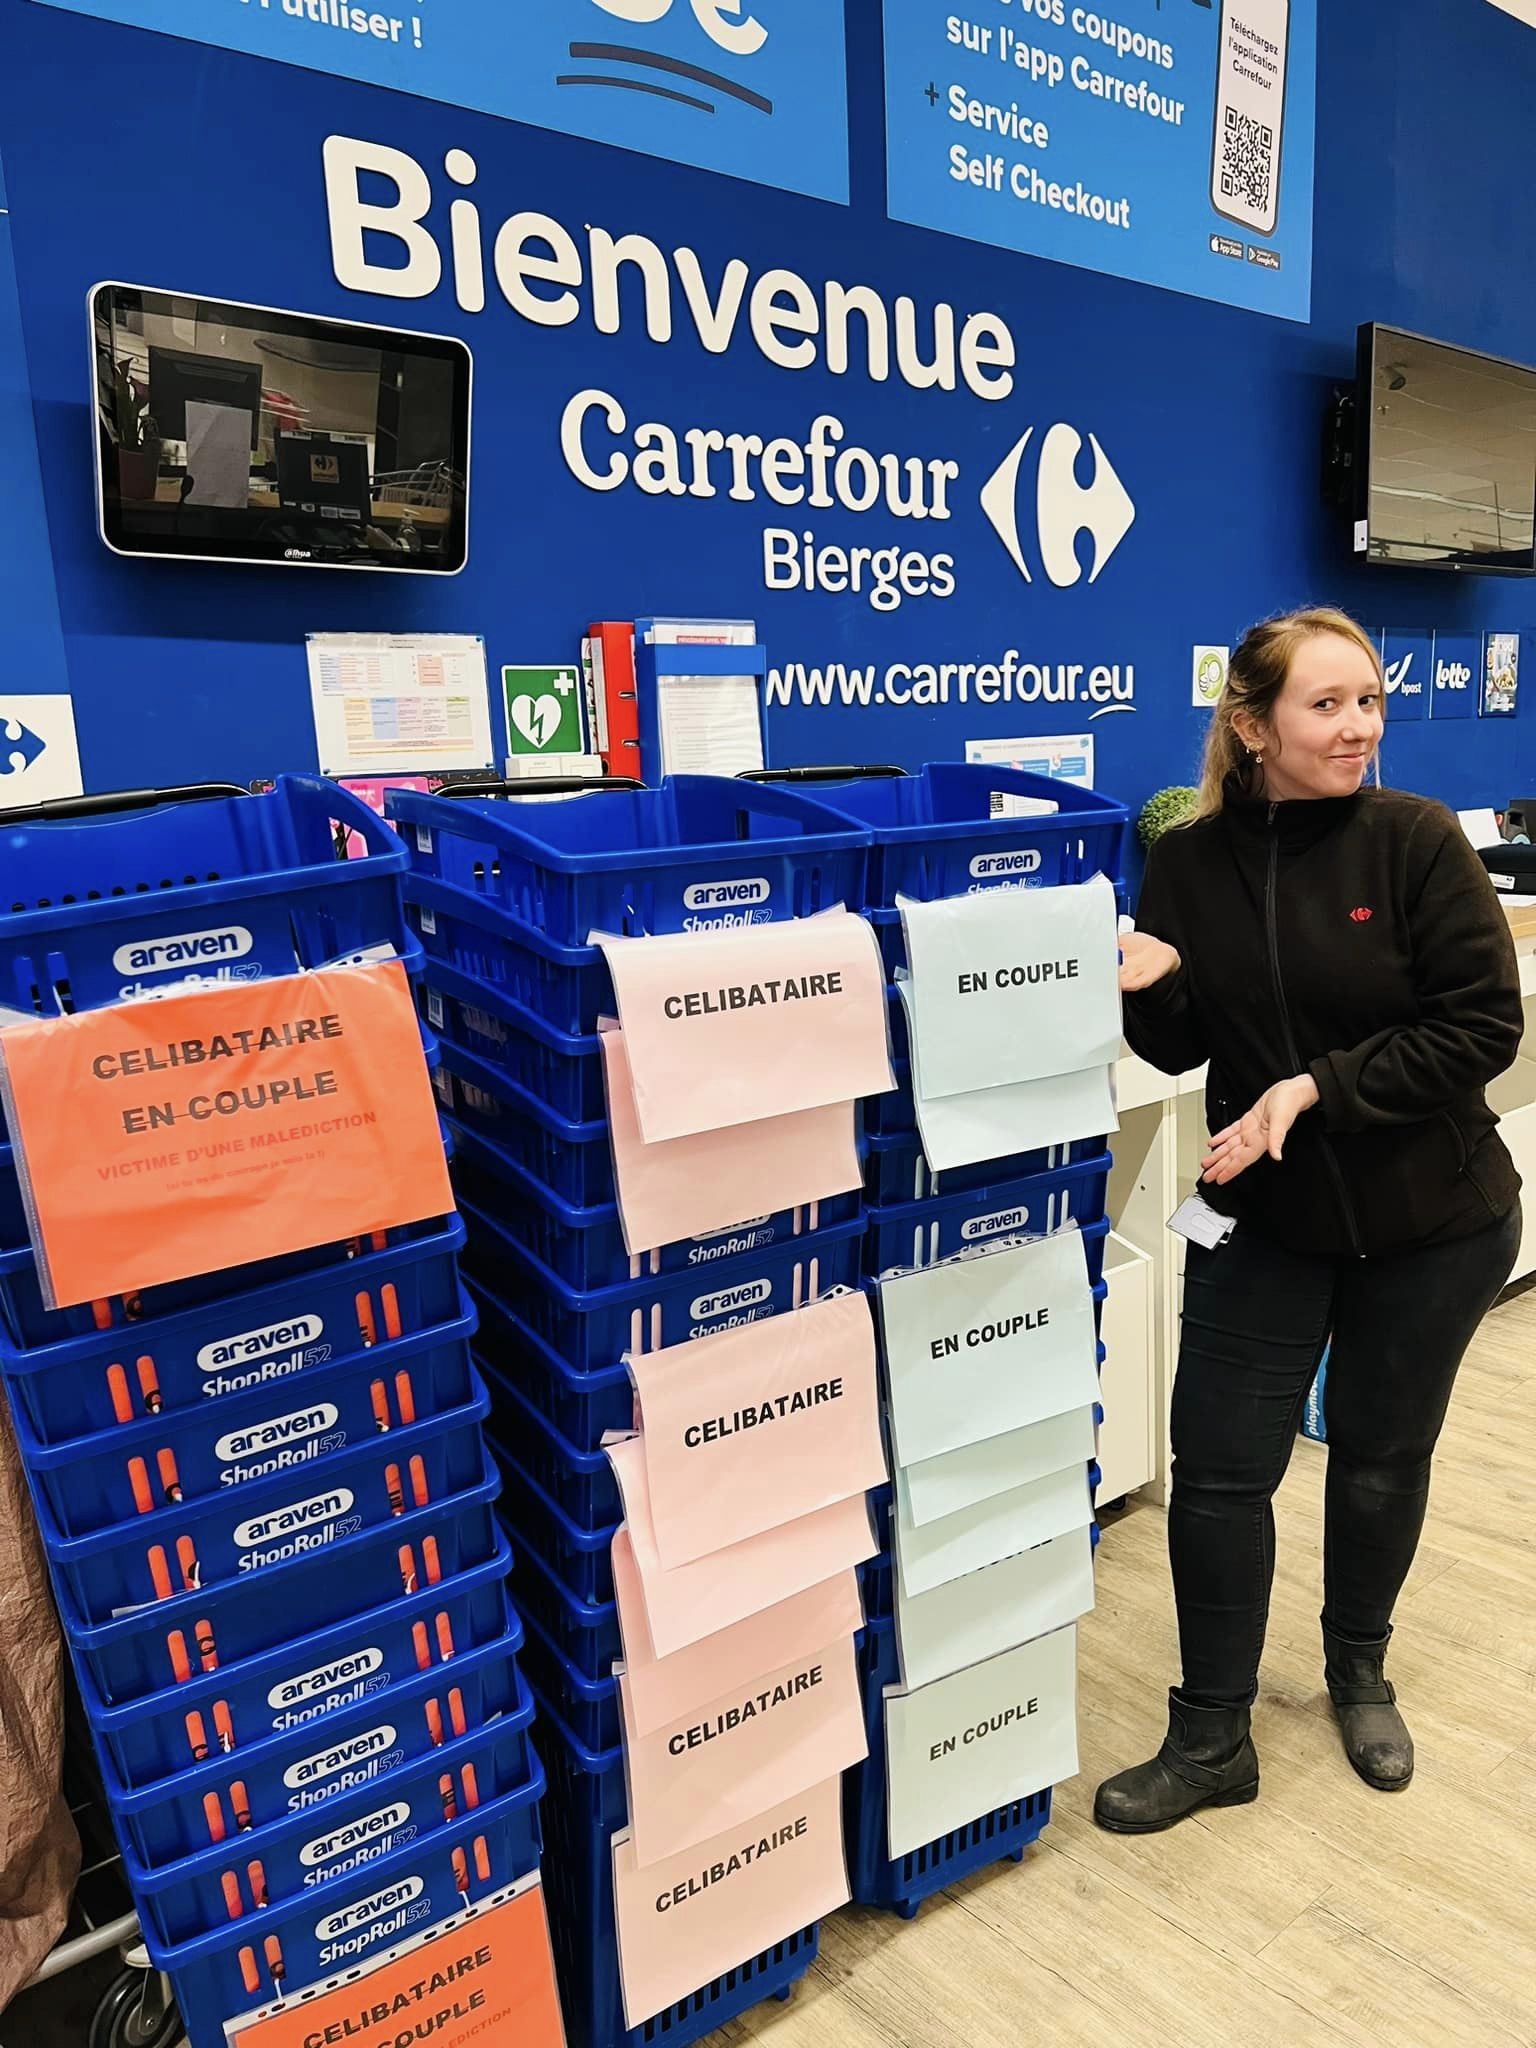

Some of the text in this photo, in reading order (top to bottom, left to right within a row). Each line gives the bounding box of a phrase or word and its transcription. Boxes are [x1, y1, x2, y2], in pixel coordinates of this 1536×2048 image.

[1072, 8, 1174, 69] coupons
[1229, 36, 1278, 75] l'application
[1230, 16, 1279, 56] Téléchargez
[947, 16, 1185, 126] sur l'app Carrefour
[1233, 59, 1272, 90] Carrefour
[948, 85, 1049, 149] Service
[949, 145, 1130, 229] Self Checkout
[322, 133, 1017, 402] Bienvenue
[559, 388, 961, 521] Carrefour
[763, 527, 957, 612] Bierges
[766, 650, 1136, 708] www.carrefour.eu
[977, 853, 1034, 873] araven
[693, 882, 761, 905] araven
[128, 932, 240, 970] araven
[957, 958, 1080, 995] EN COUPLE
[663, 970, 844, 1020] CELIBATAIRE
[92, 1014, 344, 1080] CELIBATAIRE
[121, 1069, 339, 1134] EN COUPLE
[96, 1151, 181, 1182] VICTIME
[186, 1138, 246, 1163] D'UNE
[249, 1110, 378, 1150] MALEDICTION
[968, 1211, 1022, 1236] araven
[699, 1284, 765, 1315] araven
[211, 1321, 312, 1366] araven
[930, 1307, 1051, 1362] EN COUPLE
[229, 1409, 327, 1456] araven
[683, 1377, 844, 1449] CELIBATAIRE
[246, 1494, 343, 1541] araven
[279, 1655, 373, 1702] araven
[669, 1665, 824, 1757] CELIBATAIRE
[929, 1698, 1040, 1762] EN COUPLE
[295, 1733, 386, 1782] araven
[312, 1808, 400, 1859] araven
[655, 1816, 809, 1914] CELIBATAIRE
[319, 1898, 432, 1967] ShopRoll52
[327, 1881, 413, 1934] araven
[303, 1945, 493, 2048] CELIBATAIRE
[377, 1989, 487, 2048] OUPLE
